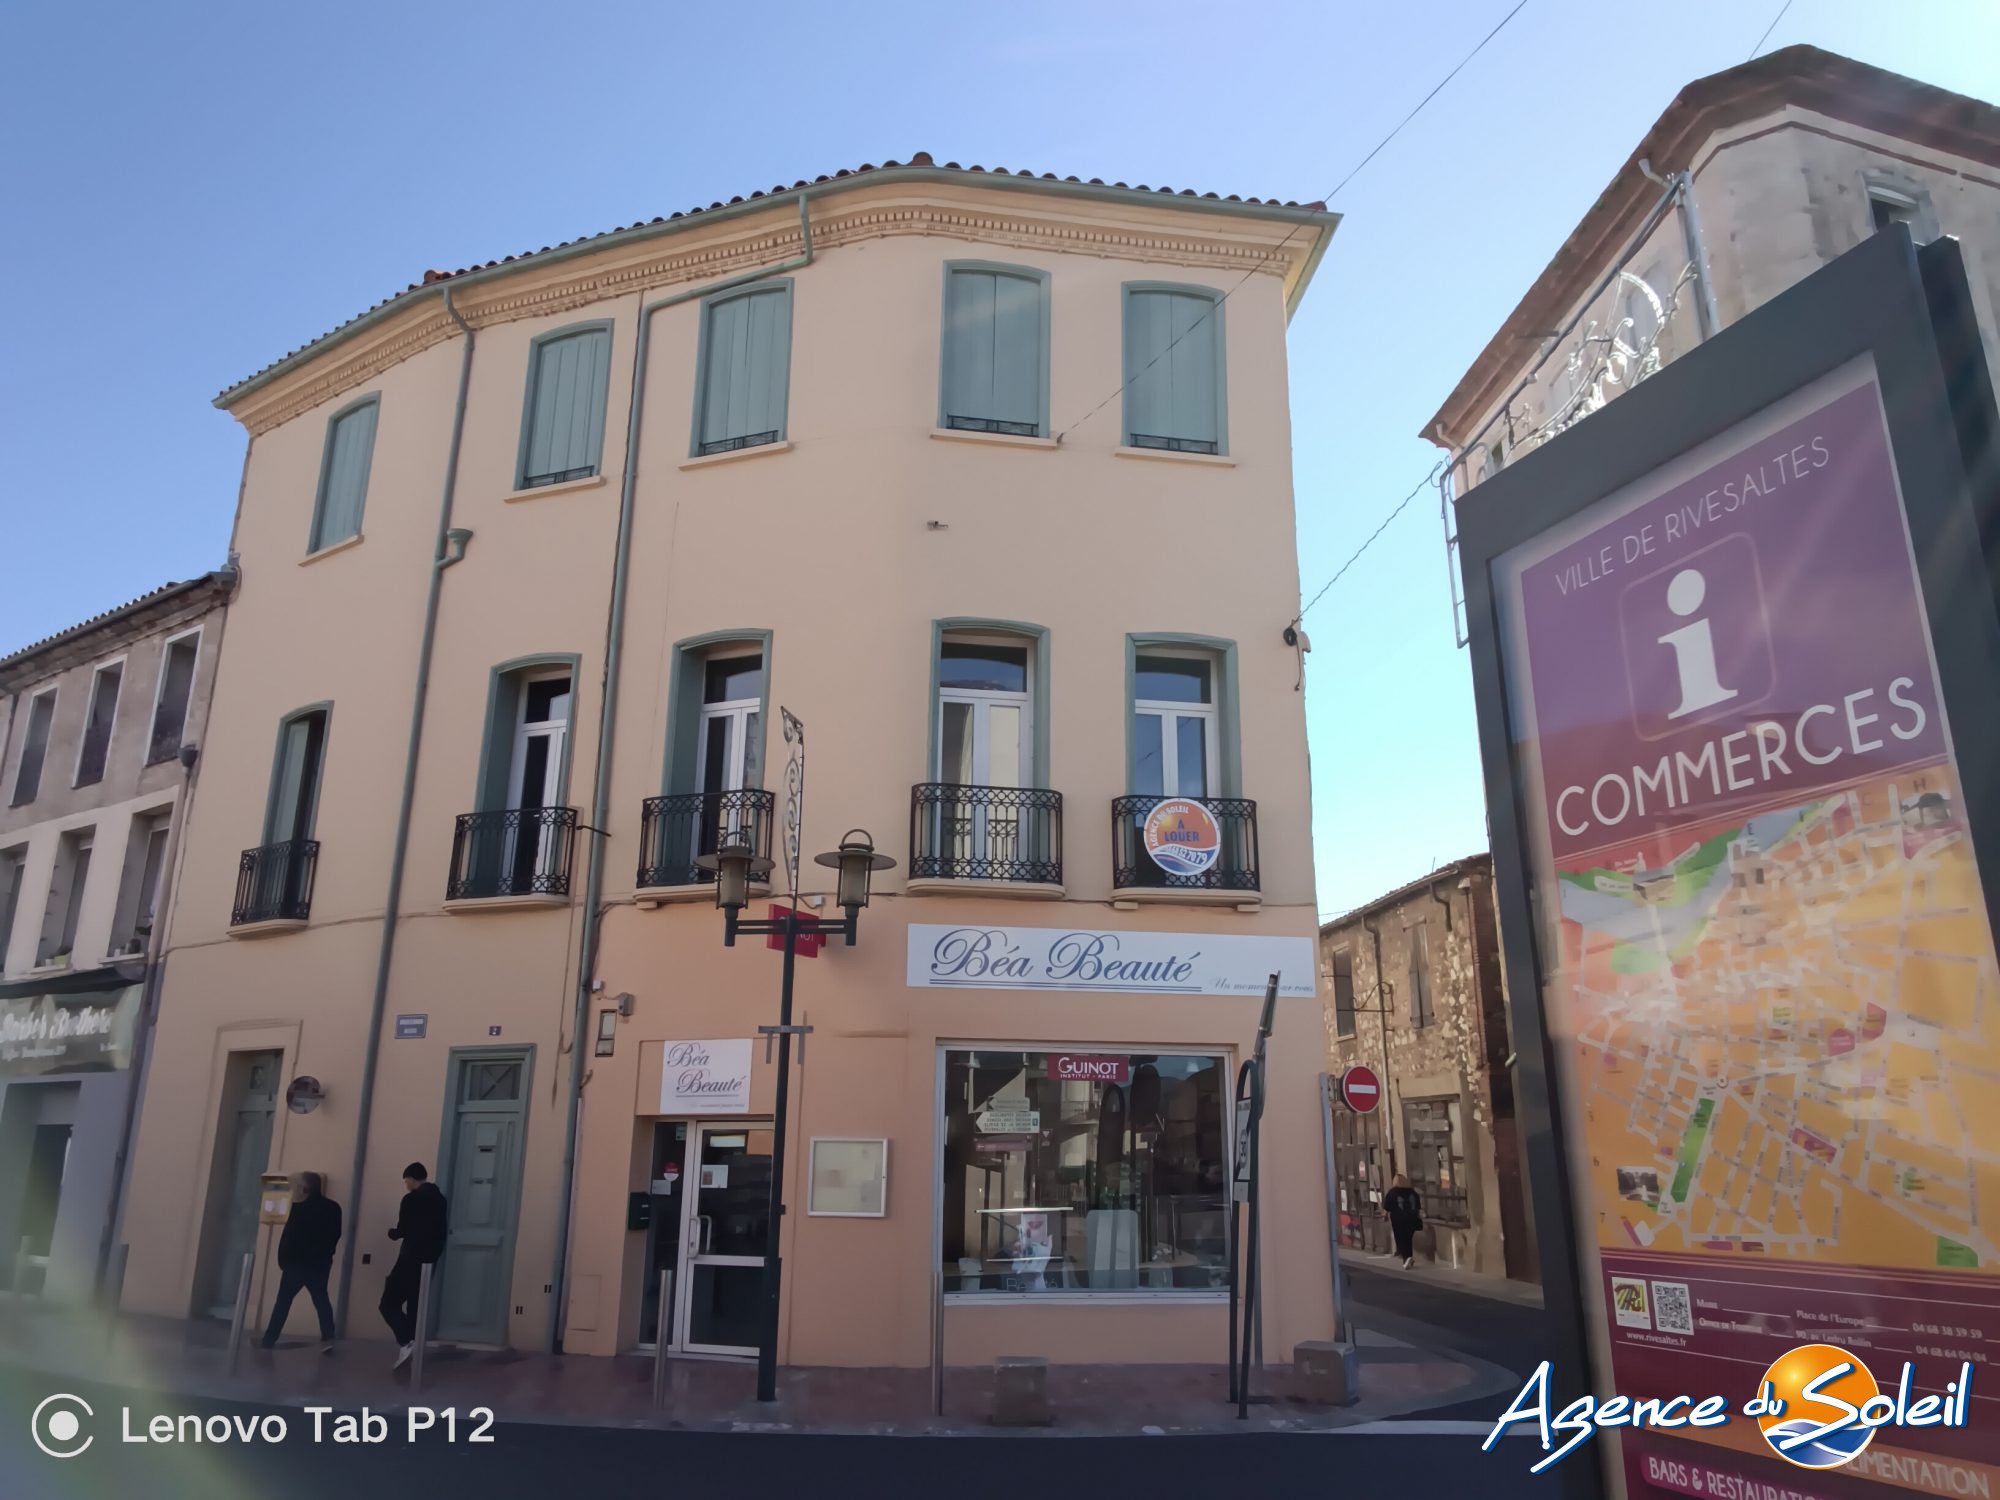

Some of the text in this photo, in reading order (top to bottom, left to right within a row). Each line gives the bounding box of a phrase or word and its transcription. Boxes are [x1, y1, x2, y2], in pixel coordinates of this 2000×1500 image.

[1556, 436, 1829, 596] VILLE DE RIVESALTES
[1556, 677, 1927, 837] COMMERCES
[1177, 818, 1185, 829] A
[1164, 831, 1199, 842] LOUER
[931, 928, 1202, 982] Béa Beauté
[667, 1043, 710, 1067] Béa
[1058, 1057, 1119, 1075] GUINOT
[676, 1069, 747, 1093] Beauté
[1627, 1331, 1687, 1347] www.rivesaltes.fr
[1648, 1456, 1688, 1488] BARS
[1691, 1471, 1703, 1491] &
[1844, 1449, 1990, 1499] LIMENTATION
